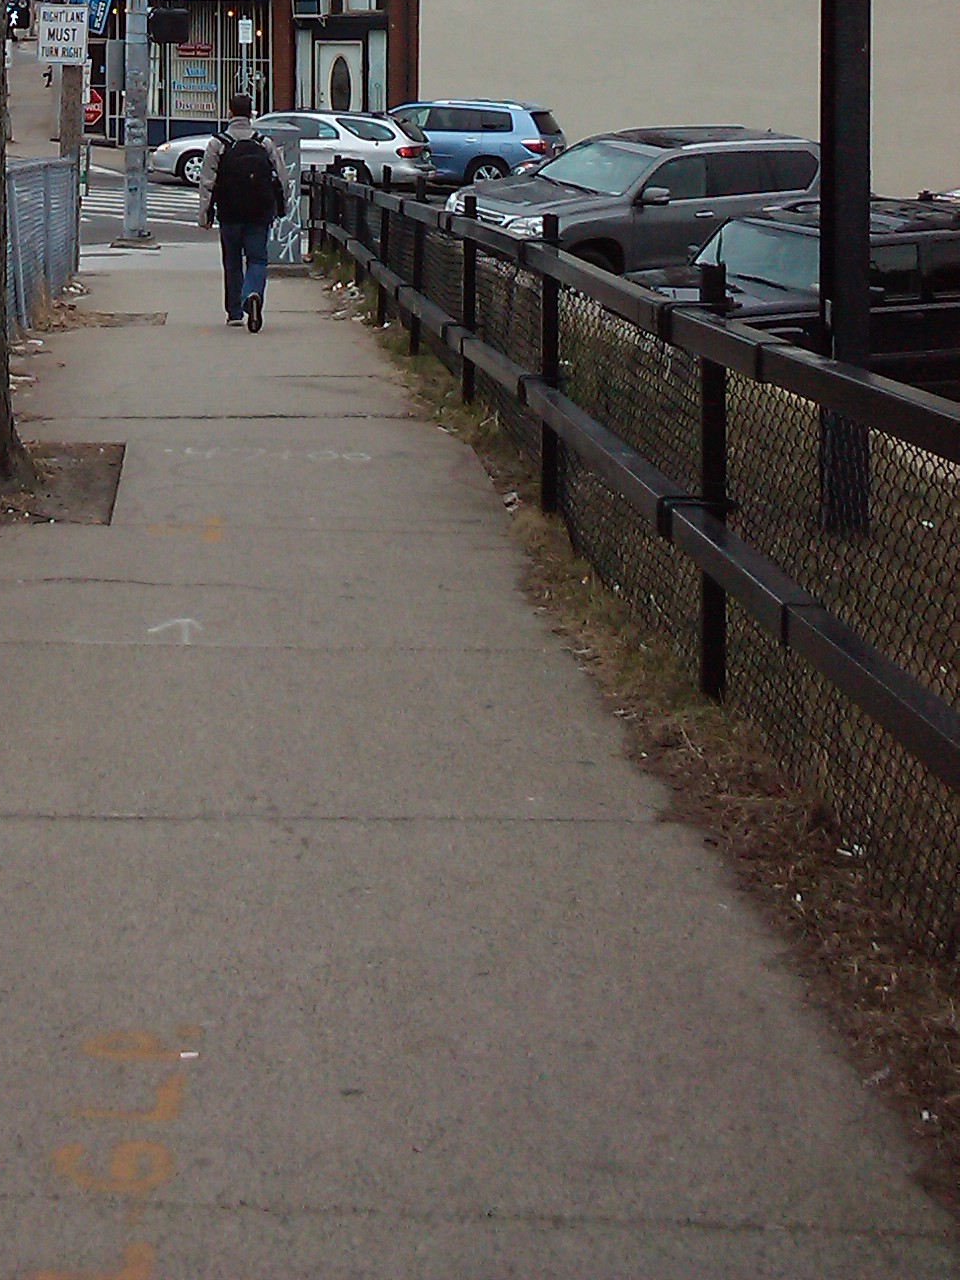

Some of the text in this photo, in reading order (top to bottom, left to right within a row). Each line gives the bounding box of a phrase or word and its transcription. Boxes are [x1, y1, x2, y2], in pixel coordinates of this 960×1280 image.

[42, 10, 85, 23] RIGHT LANE
[47, 27, 77, 42] MUST
[41, 46, 83, 58] TURN RIGHT
[184, 67, 208, 77] Auto
[173, 80, 218, 92] Insurance
[175, 99, 217, 110] Discount
